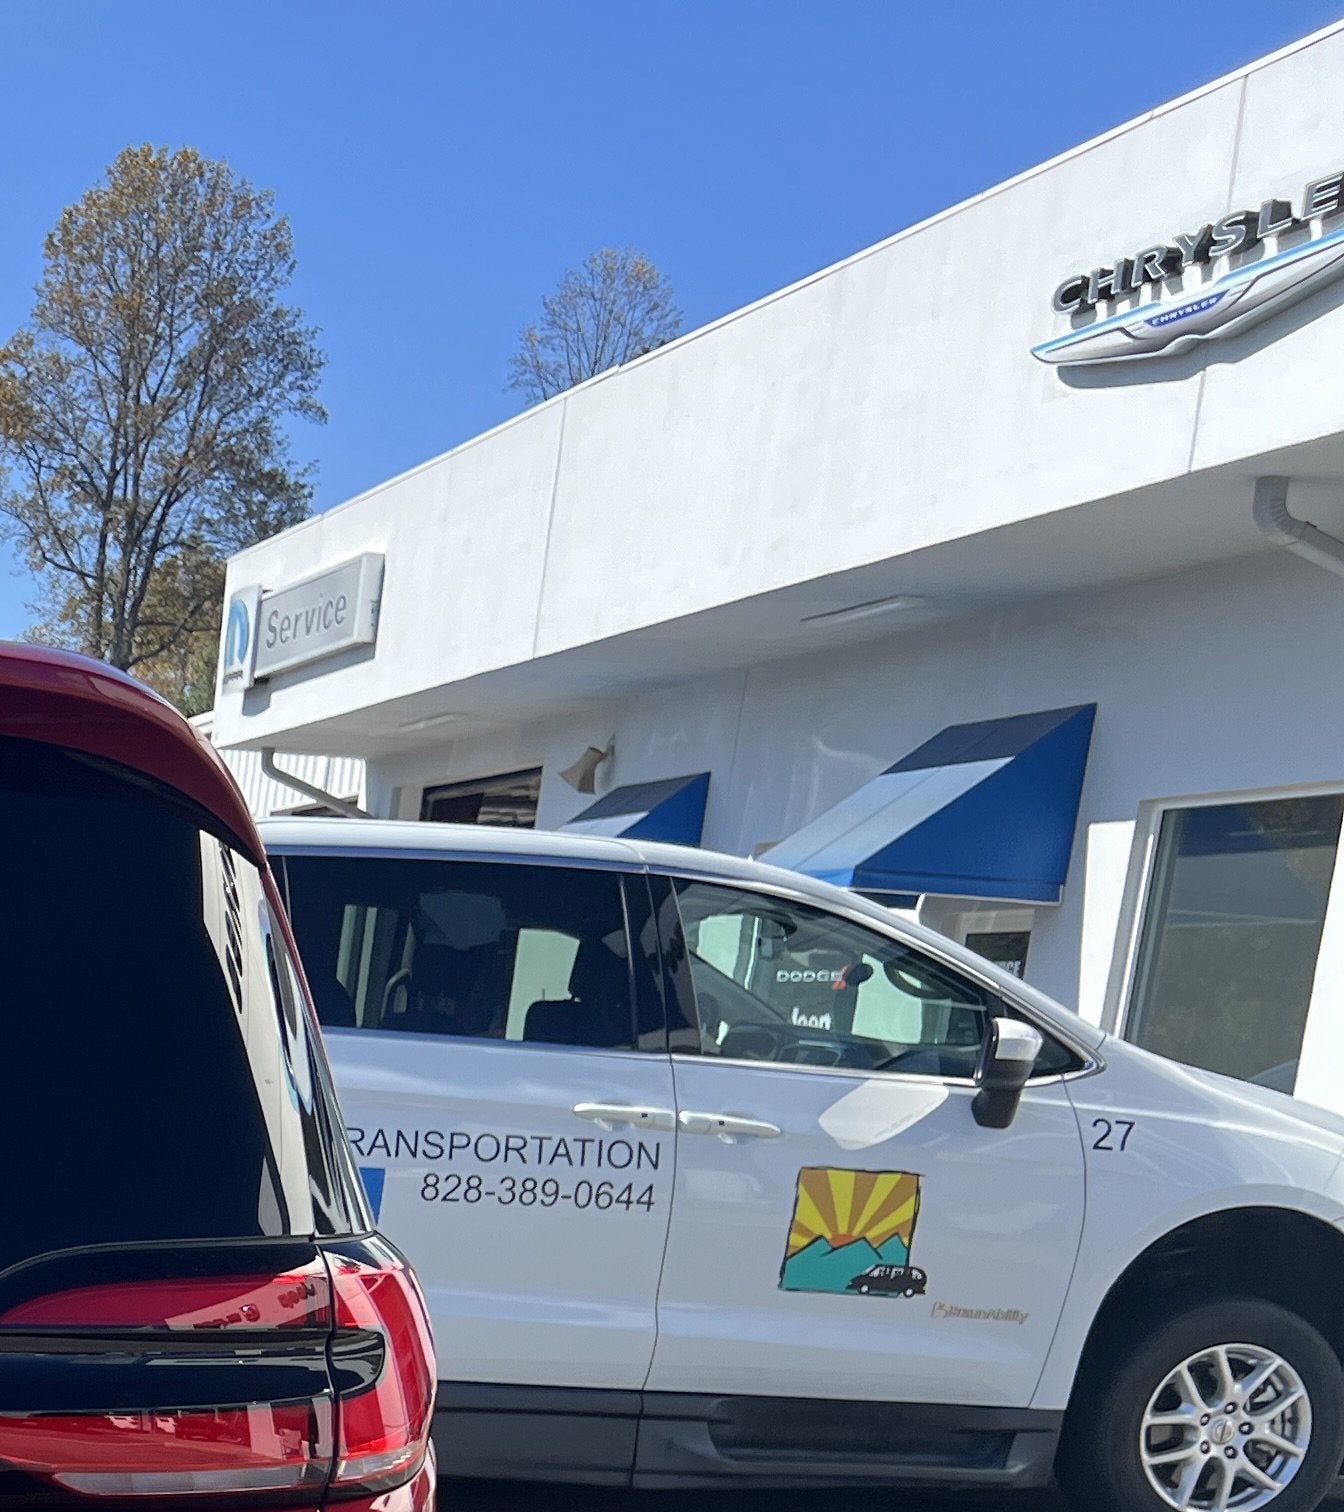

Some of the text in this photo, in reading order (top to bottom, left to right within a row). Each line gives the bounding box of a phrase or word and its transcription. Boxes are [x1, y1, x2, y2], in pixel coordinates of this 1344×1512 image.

[1050, 171, 1344, 314] CHRYSLE
[266, 593, 348, 649] Service
[345, 1126, 661, 1171] RANSPORTATION
[1092, 1118, 1136, 1152] 27
[420, 1173, 656, 1212] 828-389-0644
